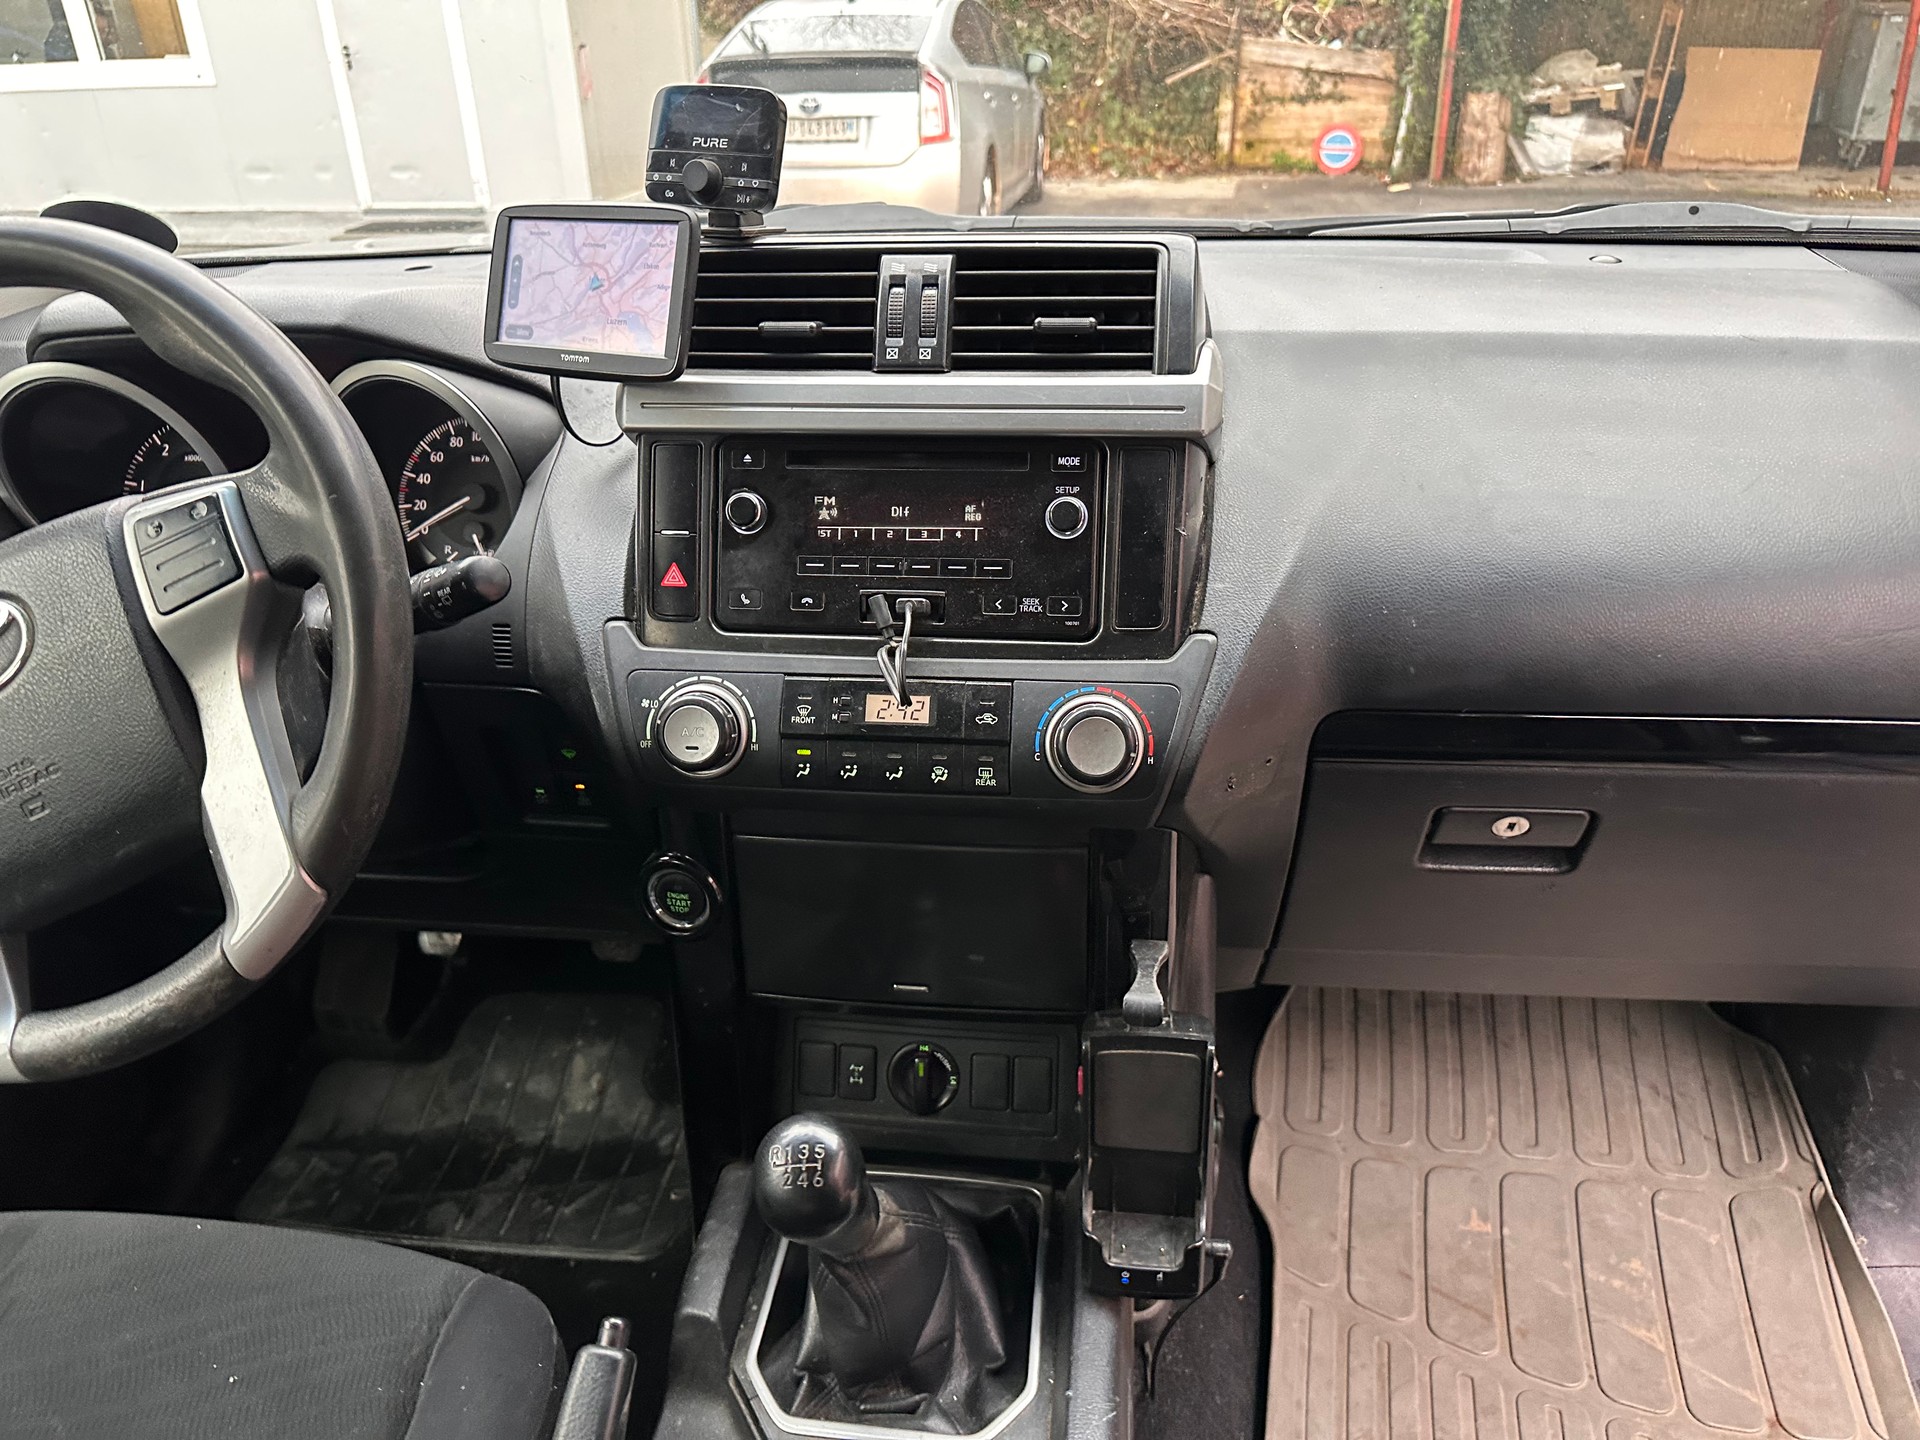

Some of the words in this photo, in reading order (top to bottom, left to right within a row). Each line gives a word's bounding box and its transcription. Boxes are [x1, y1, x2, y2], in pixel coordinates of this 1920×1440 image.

[692, 137, 729, 148] PURE
[449, 436, 464, 448] 80
[161, 443, 170, 457] 2
[429, 451, 444, 463] 60
[470, 454, 490, 463] km/h
[1057, 456, 1081, 466] MODE
[416, 472, 431, 485] 40
[1055, 486, 1080, 494] SETUP
[413, 499, 427, 511] 20
[814, 495, 836, 506] FM
[965, 504, 977, 513] AF
[964, 513, 982, 522] REG
[421, 525, 429, 535] 0
[853, 529, 858, 538] 1
[886, 530, 894, 538] 2
[920, 530, 928, 538] 3
[955, 530, 962, 539] 4
[444, 544, 452, 554] R
[1022, 597, 1041, 606] SEEK
[1019, 605, 1044, 613] TRACK
[650, 700, 659, 709] LO
[790, 716, 816, 725] FRONT
[681, 726, 705, 738] A/C
[640, 740, 652, 749] OFF
[750, 743, 759, 752] HI
[1034, 752, 1041, 762] C
[1147, 756, 1154, 765] H
[975, 778, 997, 787] REAR
[666, 891, 690, 900] ENGINE
[666, 898, 692, 908] START
[670, 905, 690, 913] STOP
[785, 1144, 792, 1159] 1
[797, 1143, 810, 1159] 3
[814, 1143, 826, 1159] 5
[783, 1173, 793, 1189] 2
[796, 1172, 810, 1188] 4
[812, 1171, 825, 1187] 6
